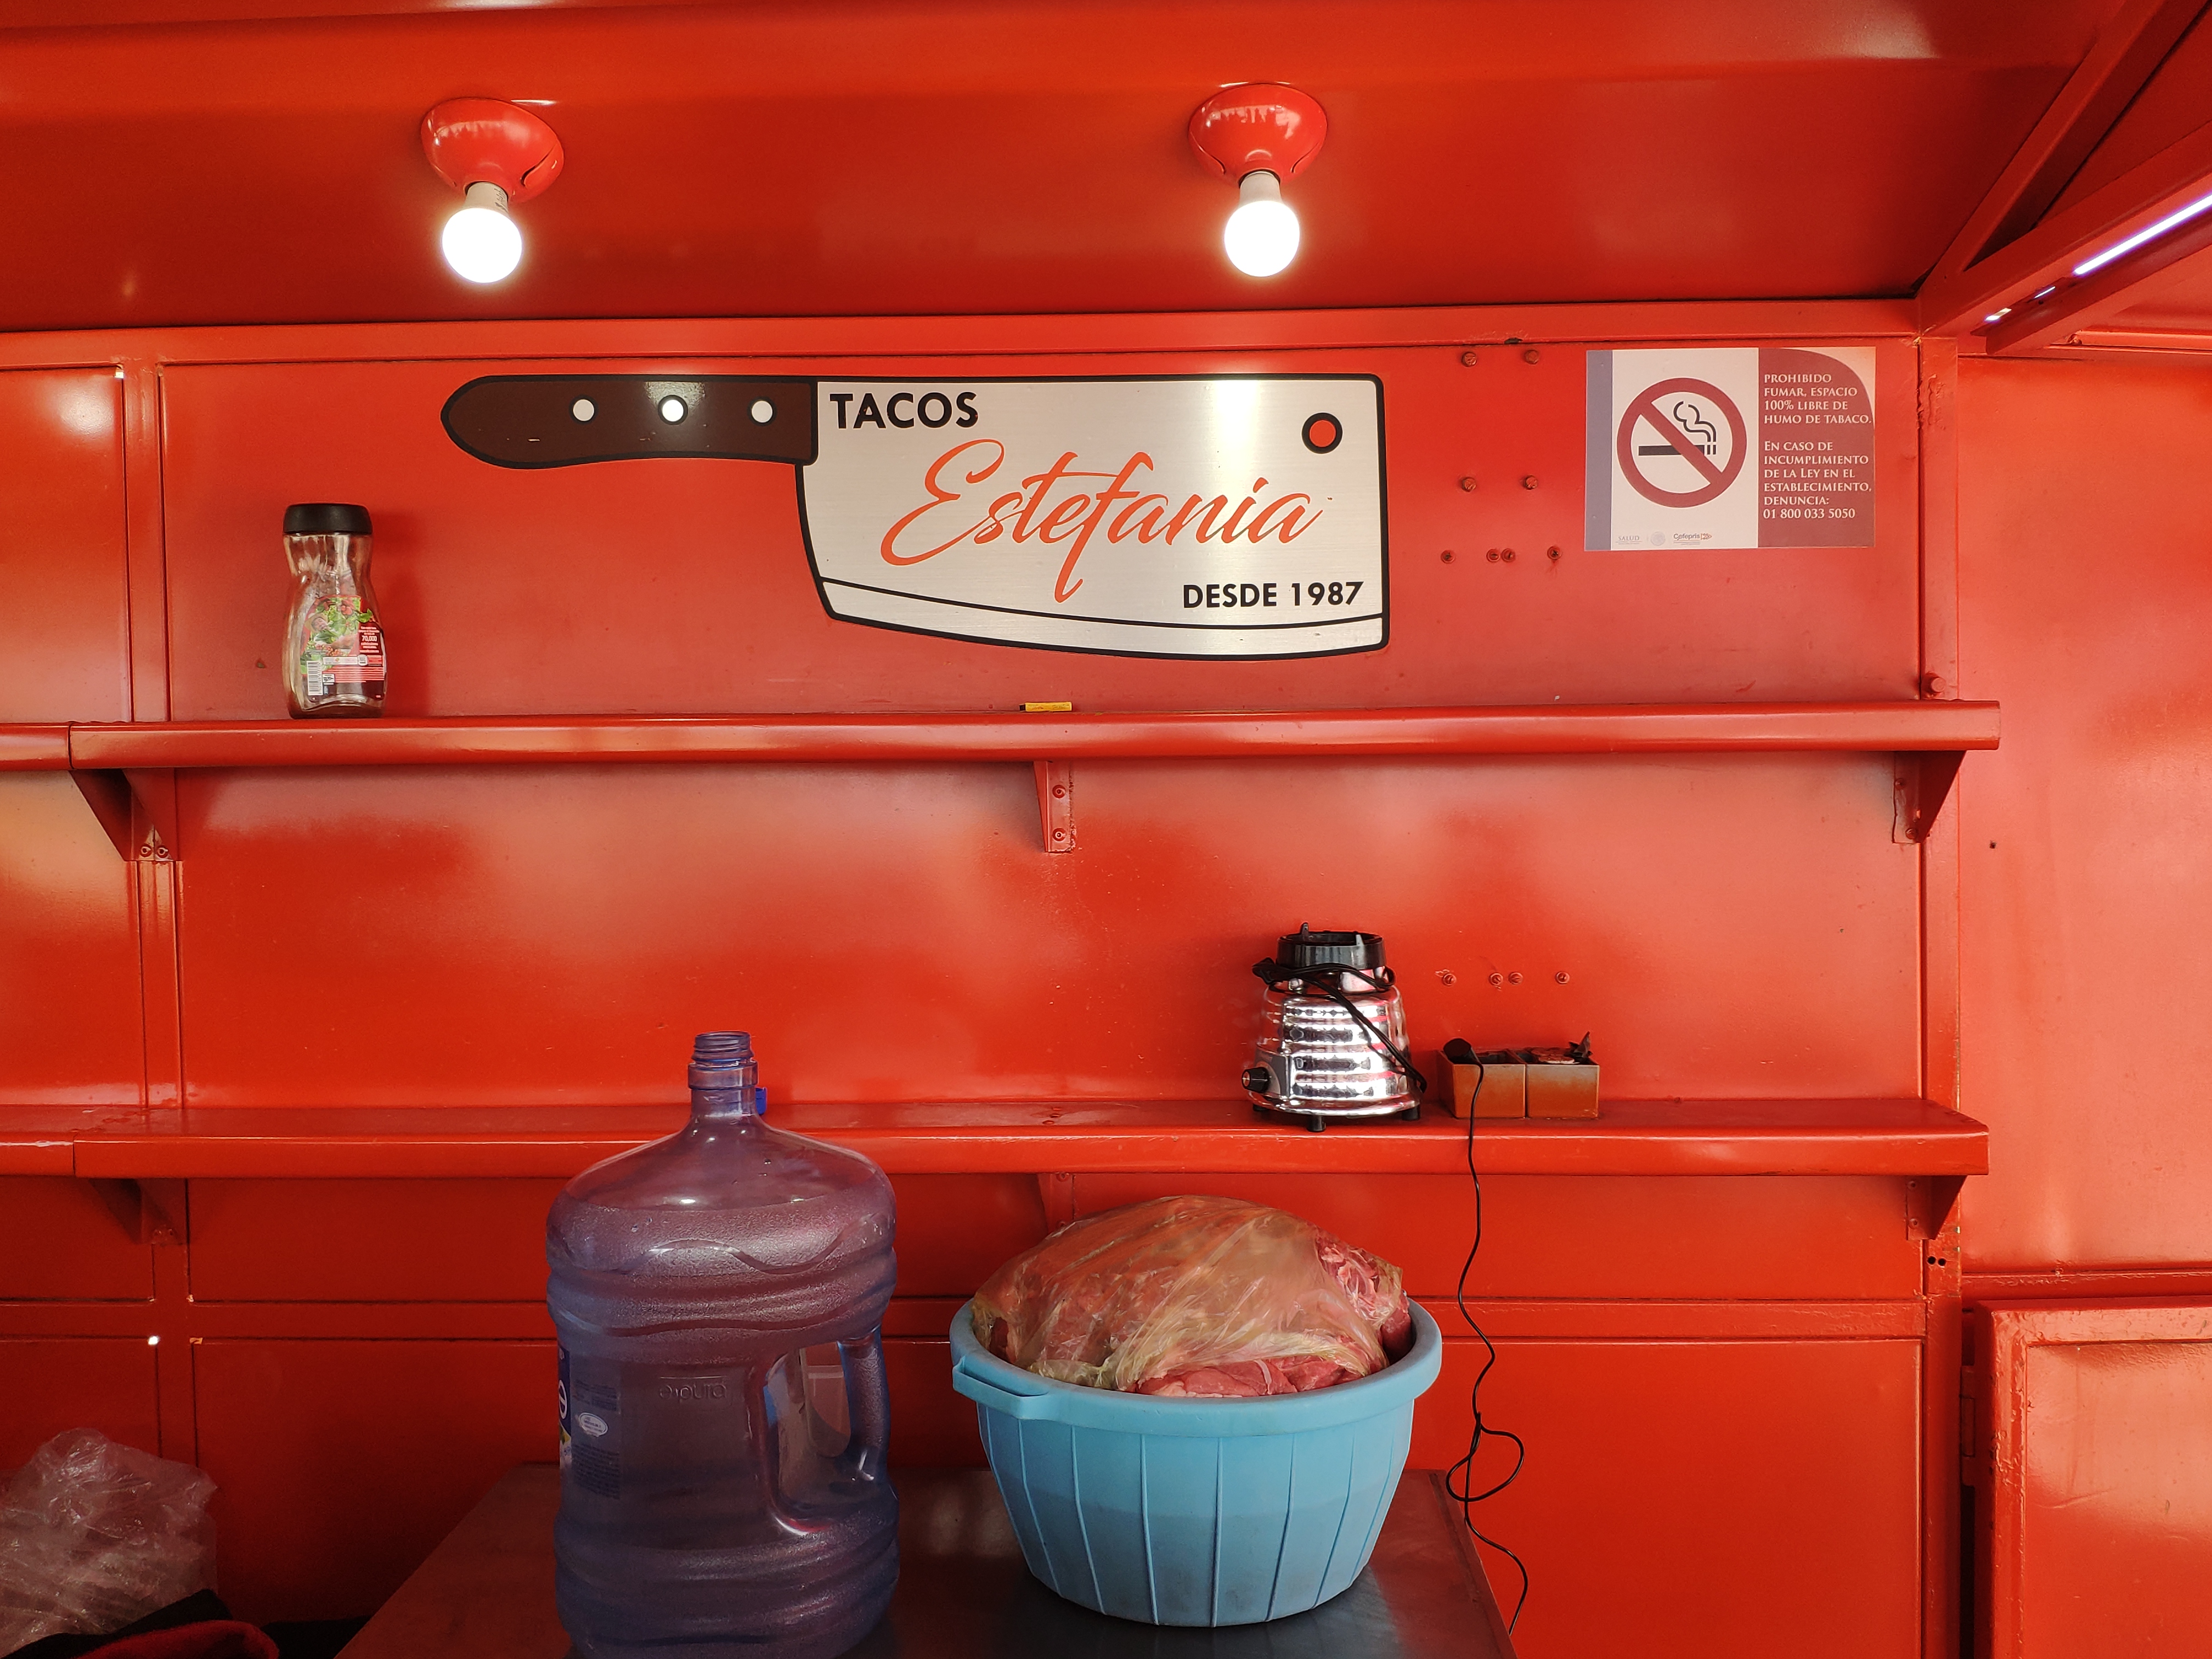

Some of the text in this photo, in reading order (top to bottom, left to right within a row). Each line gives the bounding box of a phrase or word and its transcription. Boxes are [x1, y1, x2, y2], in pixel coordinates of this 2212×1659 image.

[1764, 374, 1832, 383] PROHIBIDO
[1764, 387, 1858, 397] FUMAR, ESPACIO
[1764, 399, 1848, 410] 100% LIBRE DE
[830, 391, 978, 429] TACOS
[1764, 414, 1872, 424] HUMO DE TABACO.
[1783, 441, 1814, 451] CASO
[1818, 441, 1833, 451] DE
[1764, 455, 1869, 465] INCUMPLIMIENTO
[1764, 469, 1780, 478] DE
[1783, 469, 1797, 478] LA
[1824, 469, 1839, 478] EN
[1843, 469, 1855, 478] EL
[1764, 482, 1872, 492] ESTABLECIMIENTO,
[1764, 496, 1830, 505] DENUNCIA:
[1763, 508, 1855, 519] 01 800 033 5050
[1183, 582, 1364, 608] DESDE 1987
